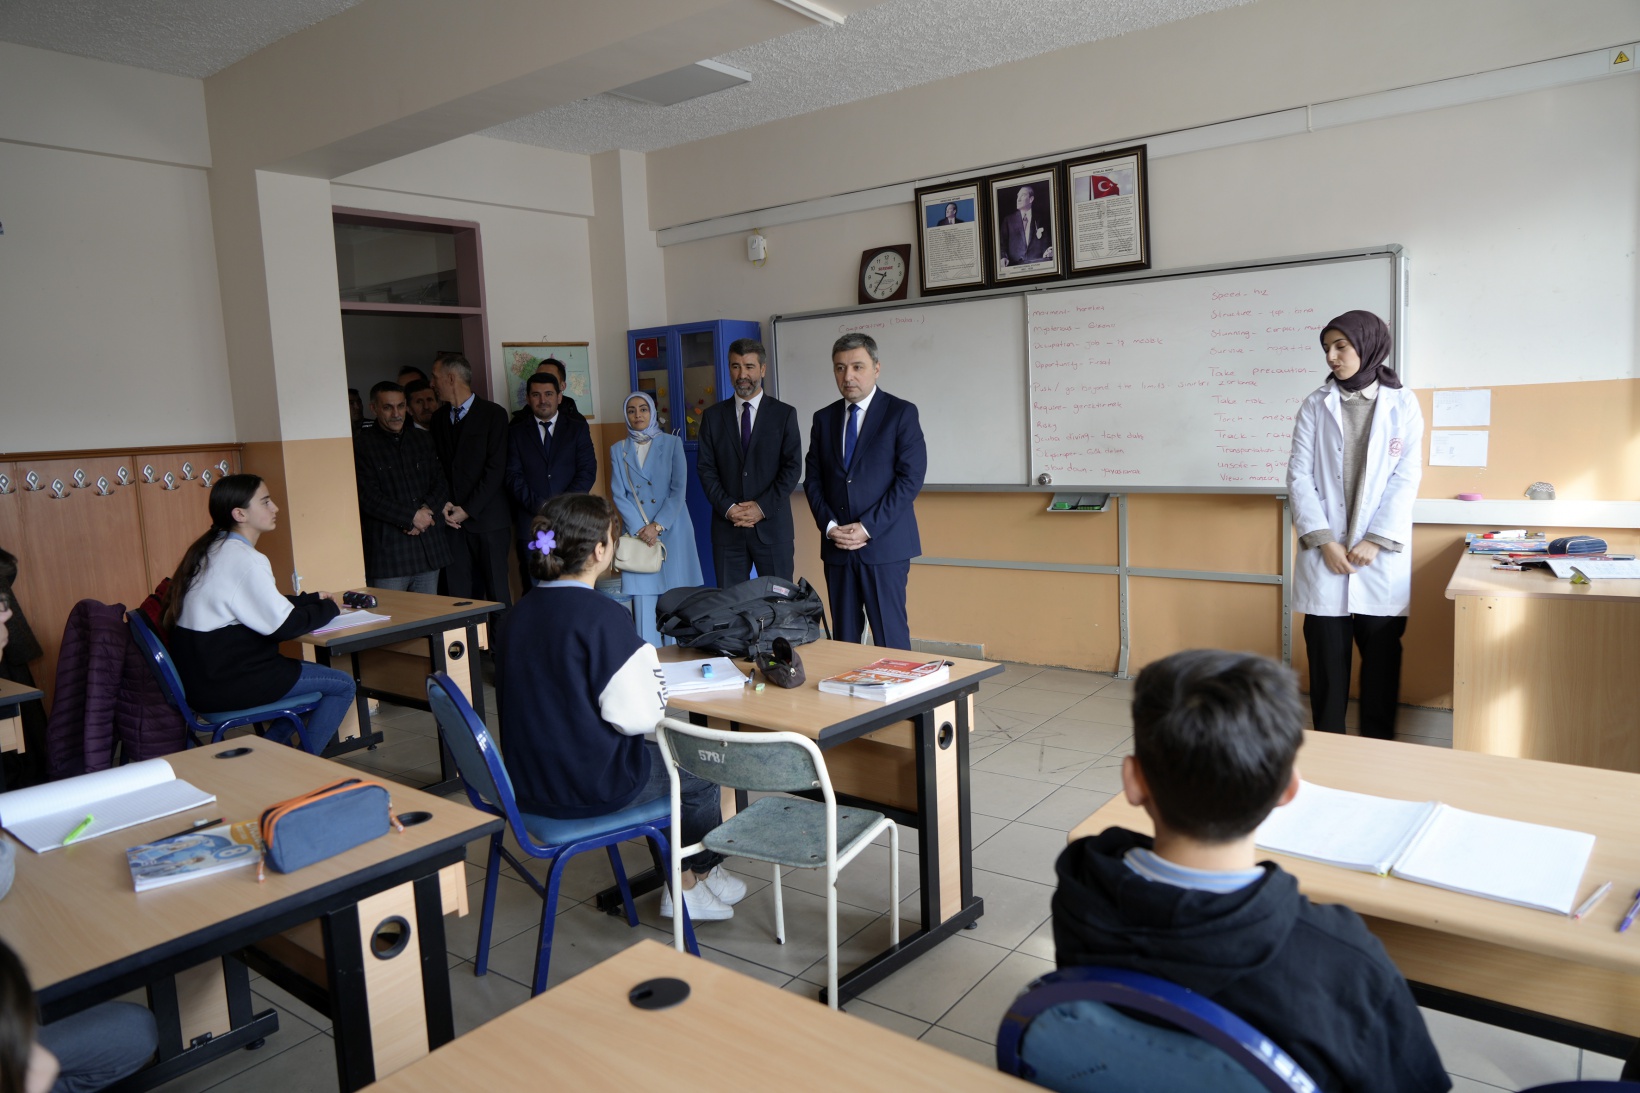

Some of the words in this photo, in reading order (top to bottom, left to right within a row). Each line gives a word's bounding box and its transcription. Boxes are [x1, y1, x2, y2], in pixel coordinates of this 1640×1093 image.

[1207, 366, 1237, 377] Take
[1213, 412, 1243, 423] Torch
[1213, 429, 1248, 440] Track
